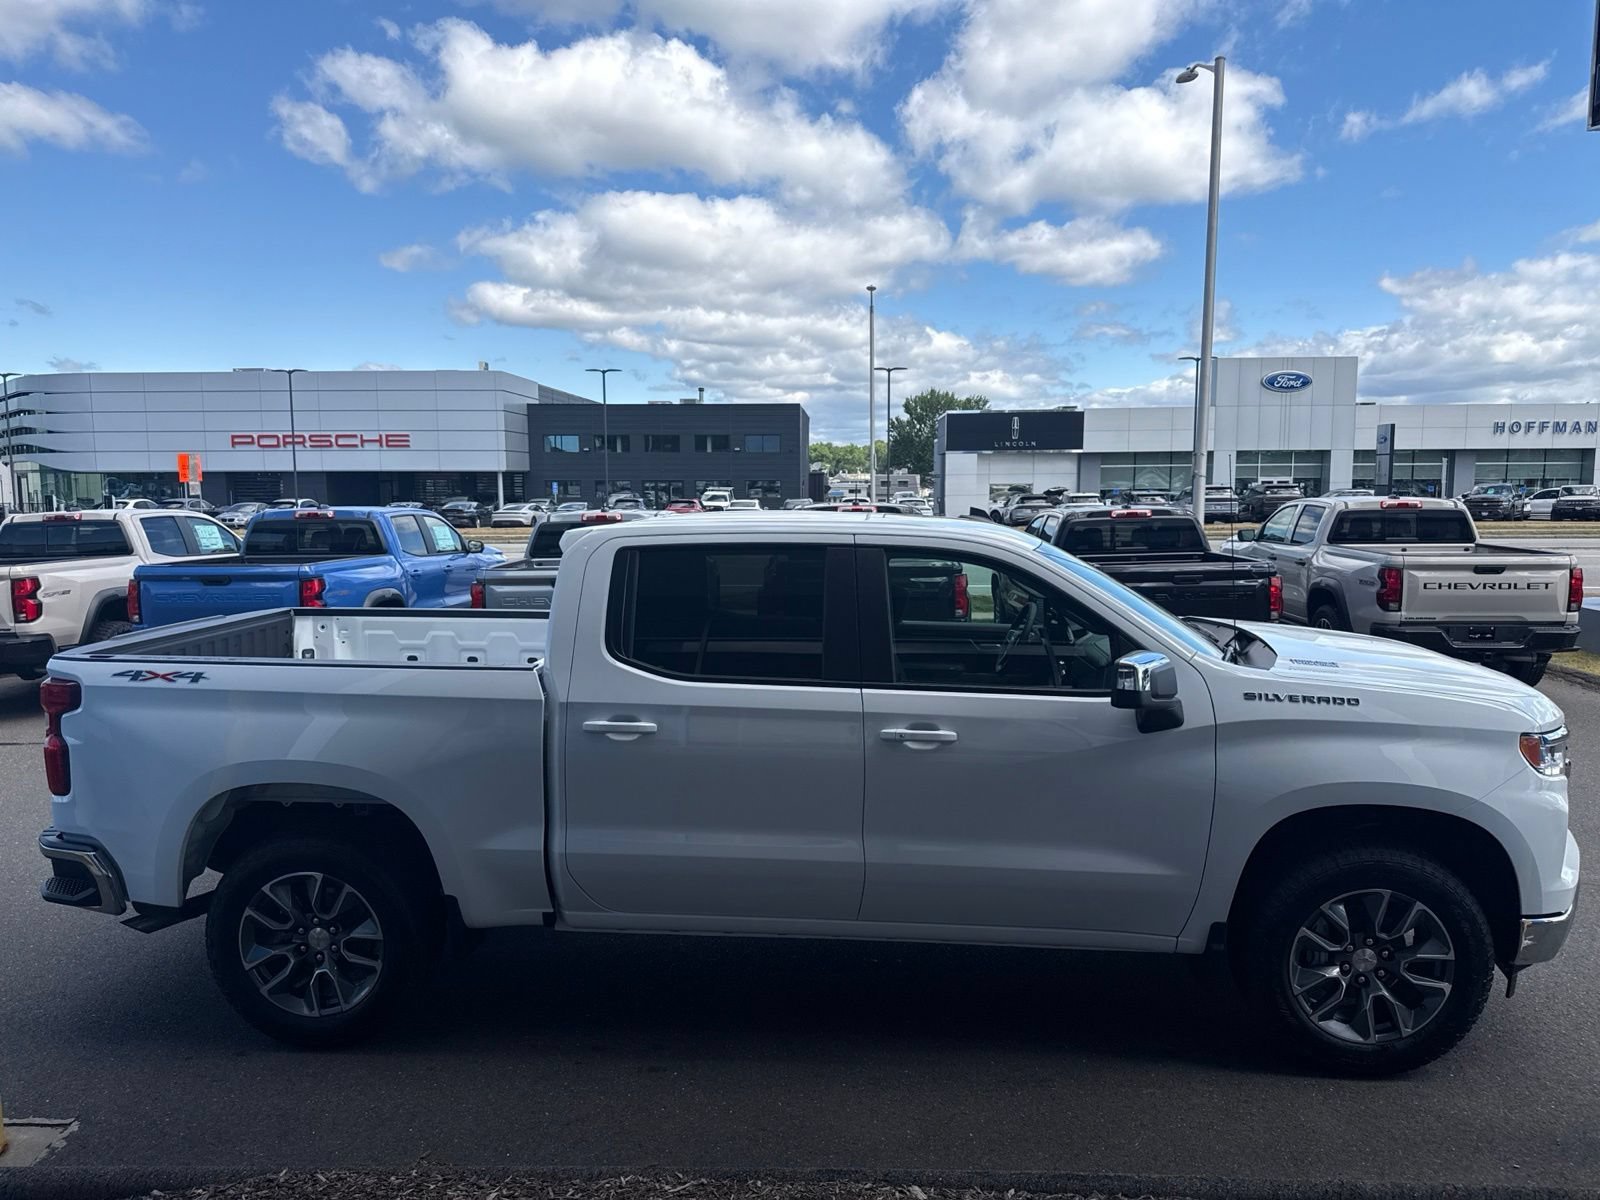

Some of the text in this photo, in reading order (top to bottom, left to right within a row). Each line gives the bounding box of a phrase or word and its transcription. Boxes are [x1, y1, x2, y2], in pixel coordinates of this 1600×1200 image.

[1274, 375, 1304, 387] Ford
[1494, 421, 1598, 434] HOFFMAN
[230, 433, 411, 449] PORSCHE
[1423, 582, 1554, 591] CHEVROLET
[1243, 692, 1360, 706] SILVERADO
